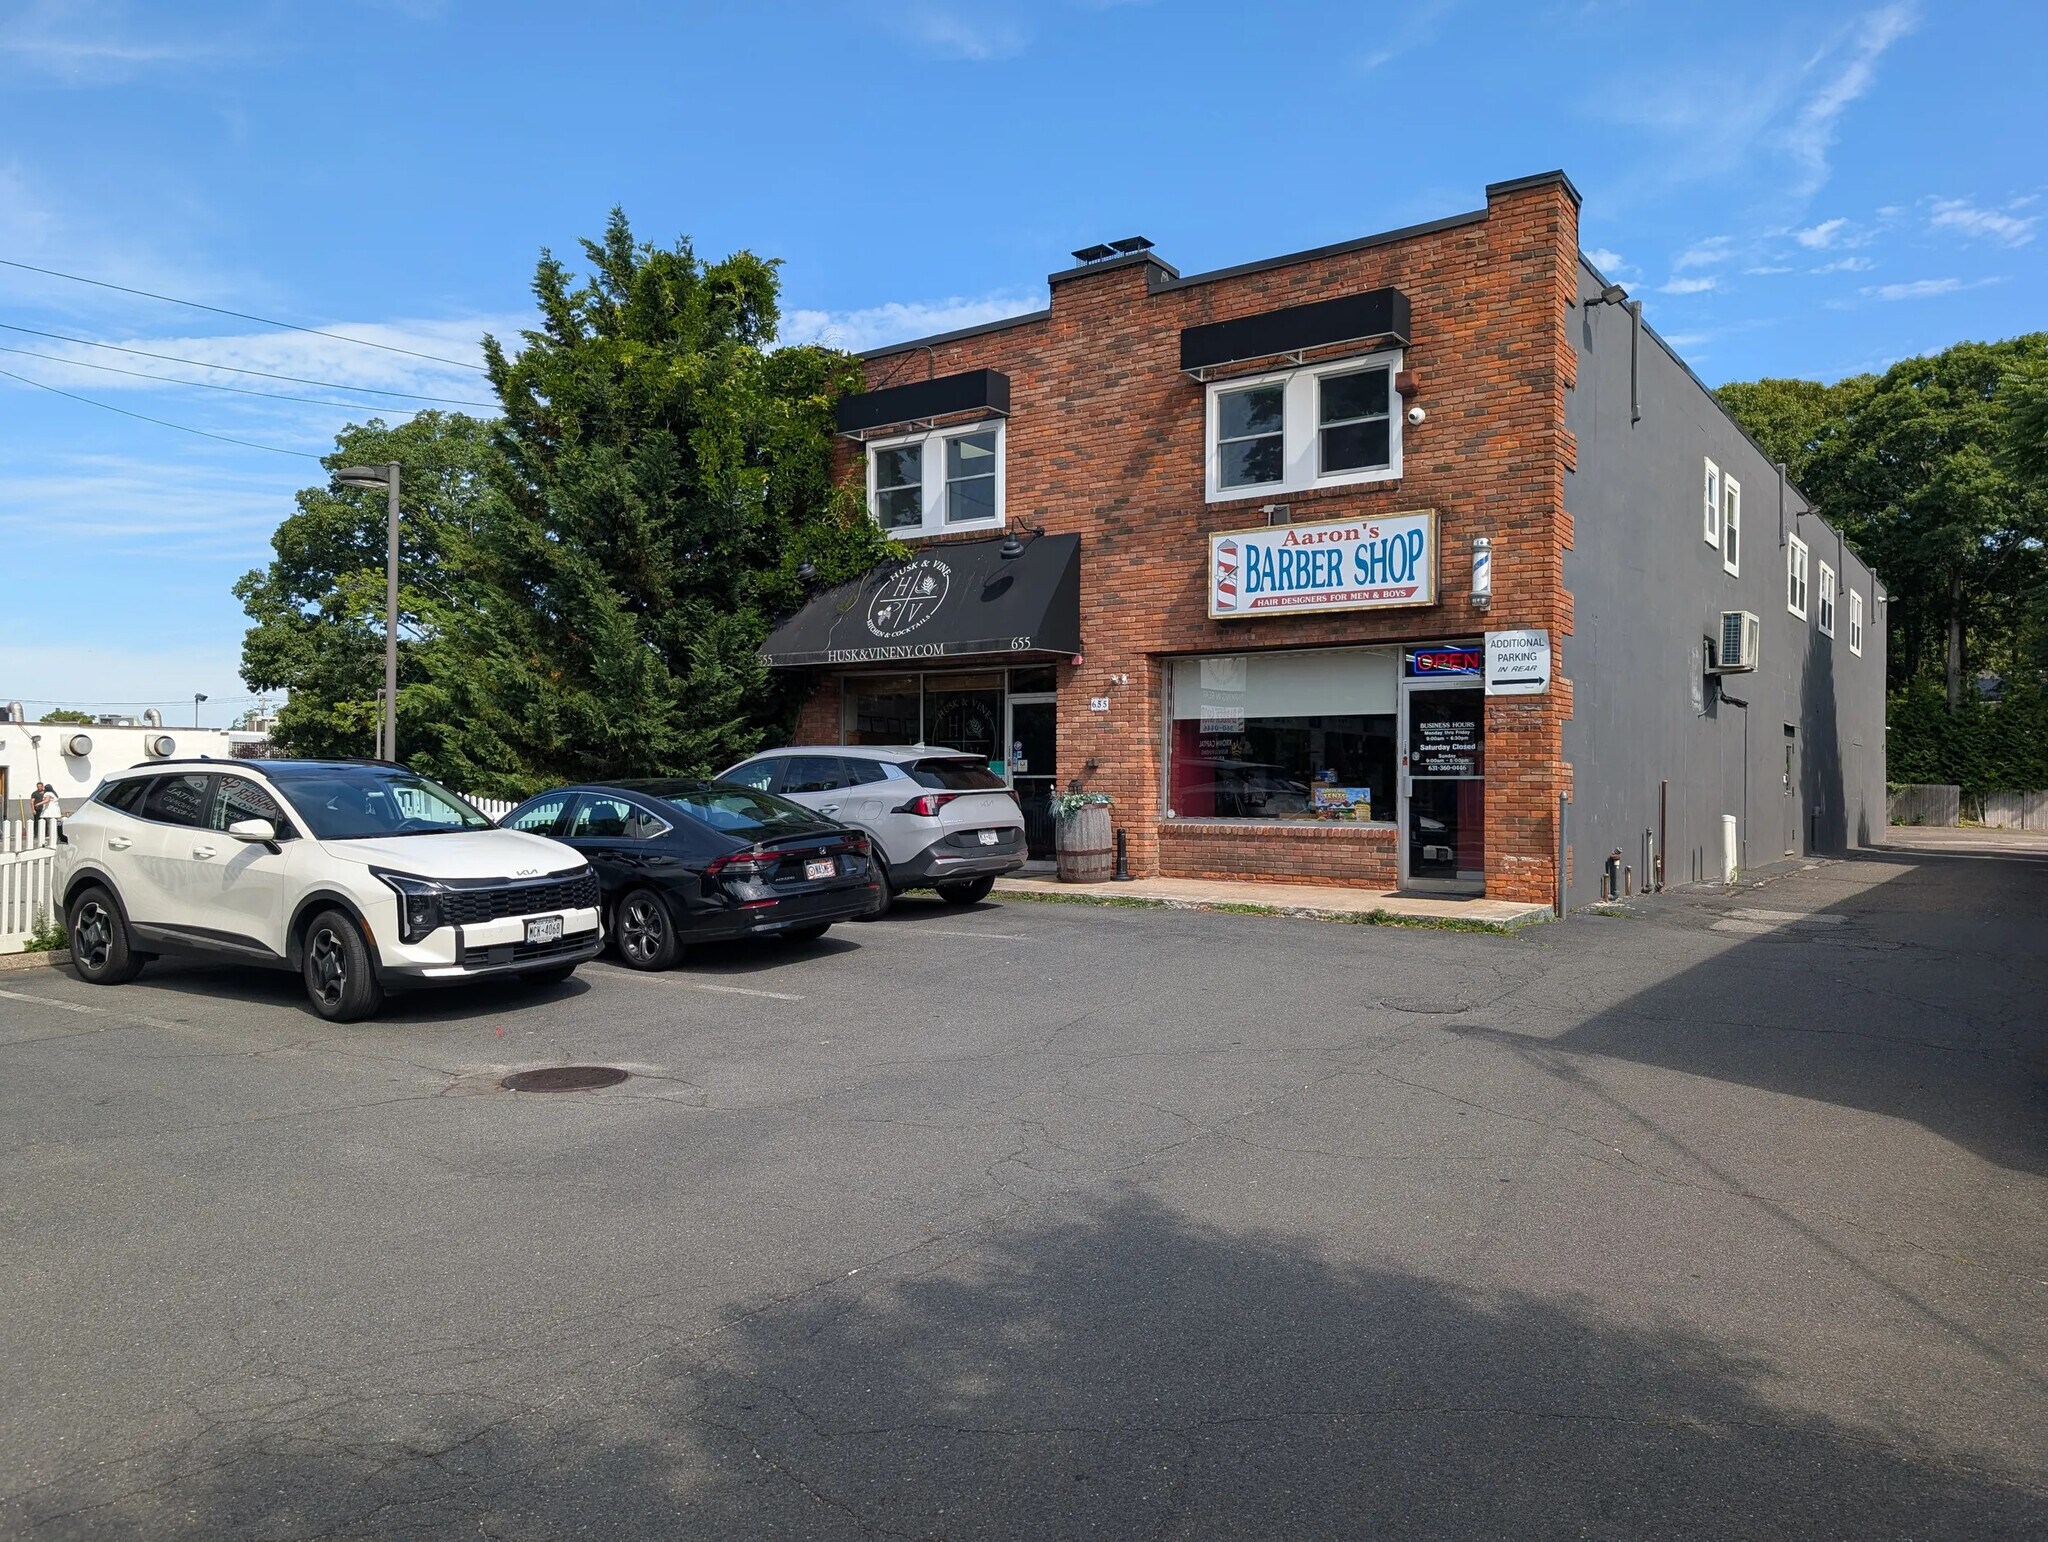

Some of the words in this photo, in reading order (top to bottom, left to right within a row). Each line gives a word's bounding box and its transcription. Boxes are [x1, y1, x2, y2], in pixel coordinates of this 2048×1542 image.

[1282, 523, 1380, 547] Aaron's
[1245, 544, 1344, 593] BARBER
[1354, 528, 1424, 586] SHOP
[890, 561, 919, 581] HUSK
[932, 560, 952, 577] VINE
[1257, 599, 1278, 607] HAIR
[1281, 595, 1327, 605] DESIGNERS
[1330, 593, 1347, 602] FOR
[1350, 592, 1369, 600] MEN
[1383, 590, 1406, 598] BOYS
[866, 619, 883, 637] KITCHEN
[891, 614, 931, 637] COCKTAILS
[1011, 636, 1031, 650] 655
[1490, 638, 1545, 648] ADDITIONAL
[828, 643, 944, 662] HUSK&VINENY.COM
[1418, 652, 1479, 670] OPEN
[1497, 652, 1537, 662] PARKING
[1511, 665, 1538, 673] REAR
[937, 699, 959, 720] HUSK
[972, 699, 992, 720] VINE
[1092, 700, 1107, 708] 655
